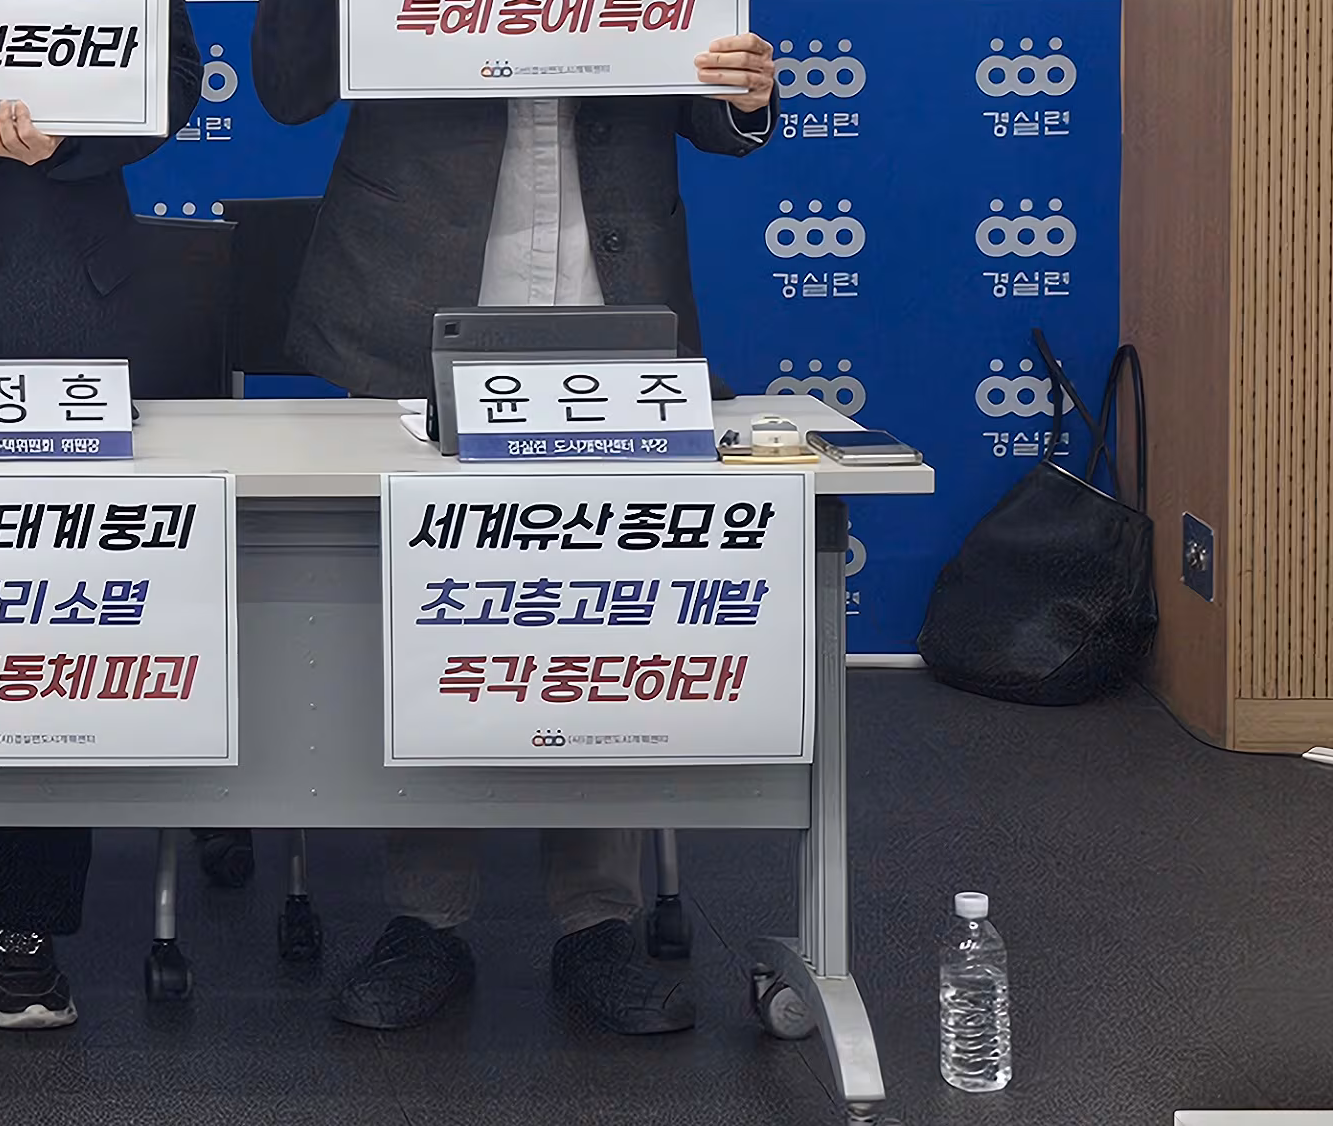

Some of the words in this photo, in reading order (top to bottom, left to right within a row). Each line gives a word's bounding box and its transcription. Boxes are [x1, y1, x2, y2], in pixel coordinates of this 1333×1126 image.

[983, 110, 1070, 137] 경실련
[773, 271, 859, 298] 경실련
[982, 271, 1070, 298] 경실련
[98, 503, 197, 552] 붕괴
[408, 502, 615, 551] 세계유산
[617, 502, 716, 551] 종묘
[719, 501, 776, 550] 앞
[48, 579, 150, 626] 소멸
[415, 577, 661, 627] 초고층고밀
[670, 579, 770, 626] 개발
[104, 654, 200, 701] 파괴
[438, 655, 538, 703] 즉각
[540, 654, 749, 704] 중단하라!
